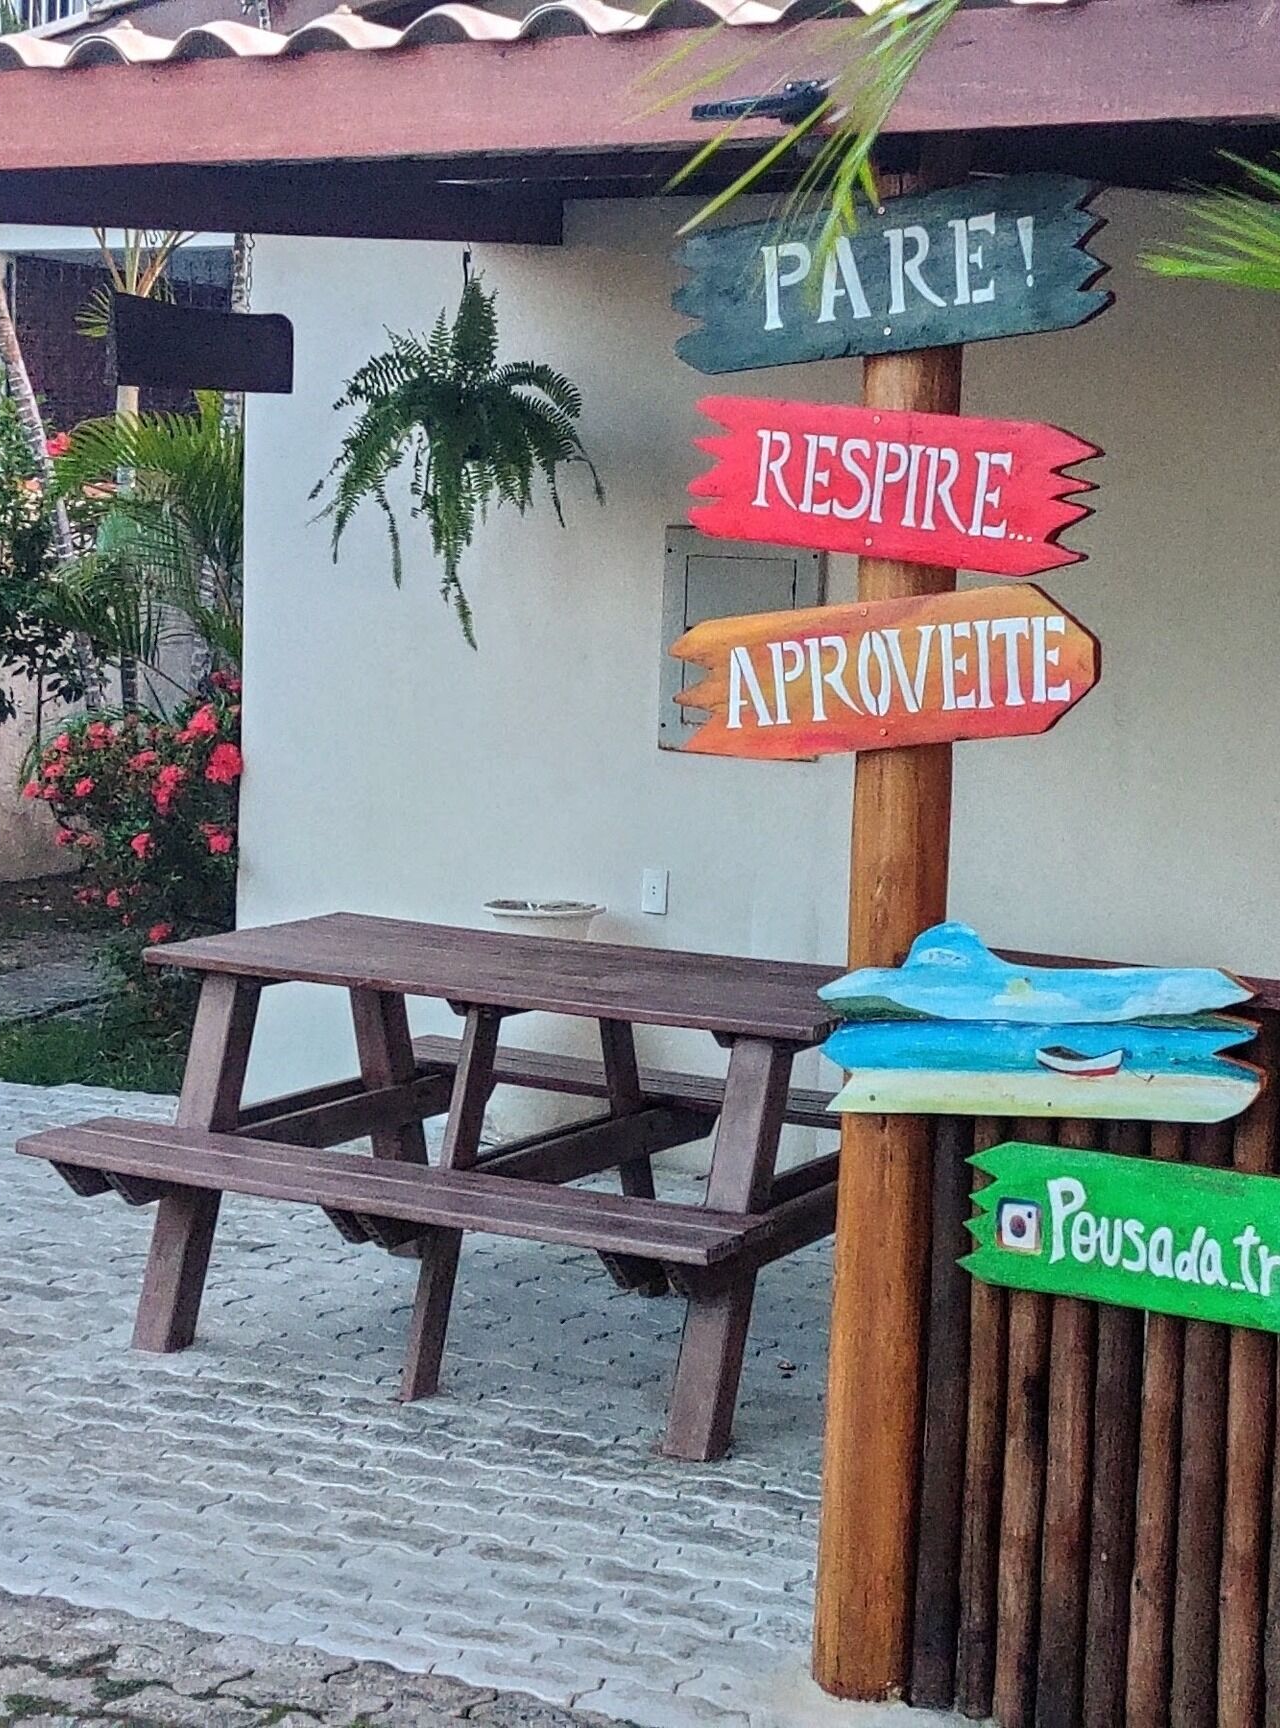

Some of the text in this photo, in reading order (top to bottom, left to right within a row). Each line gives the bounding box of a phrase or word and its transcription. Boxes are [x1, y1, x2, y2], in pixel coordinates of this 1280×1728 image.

[761, 213, 1035, 331] PARE!
[751, 429, 1033, 543] RESPIRE...
[726, 616, 1071, 730] APROVEITE
